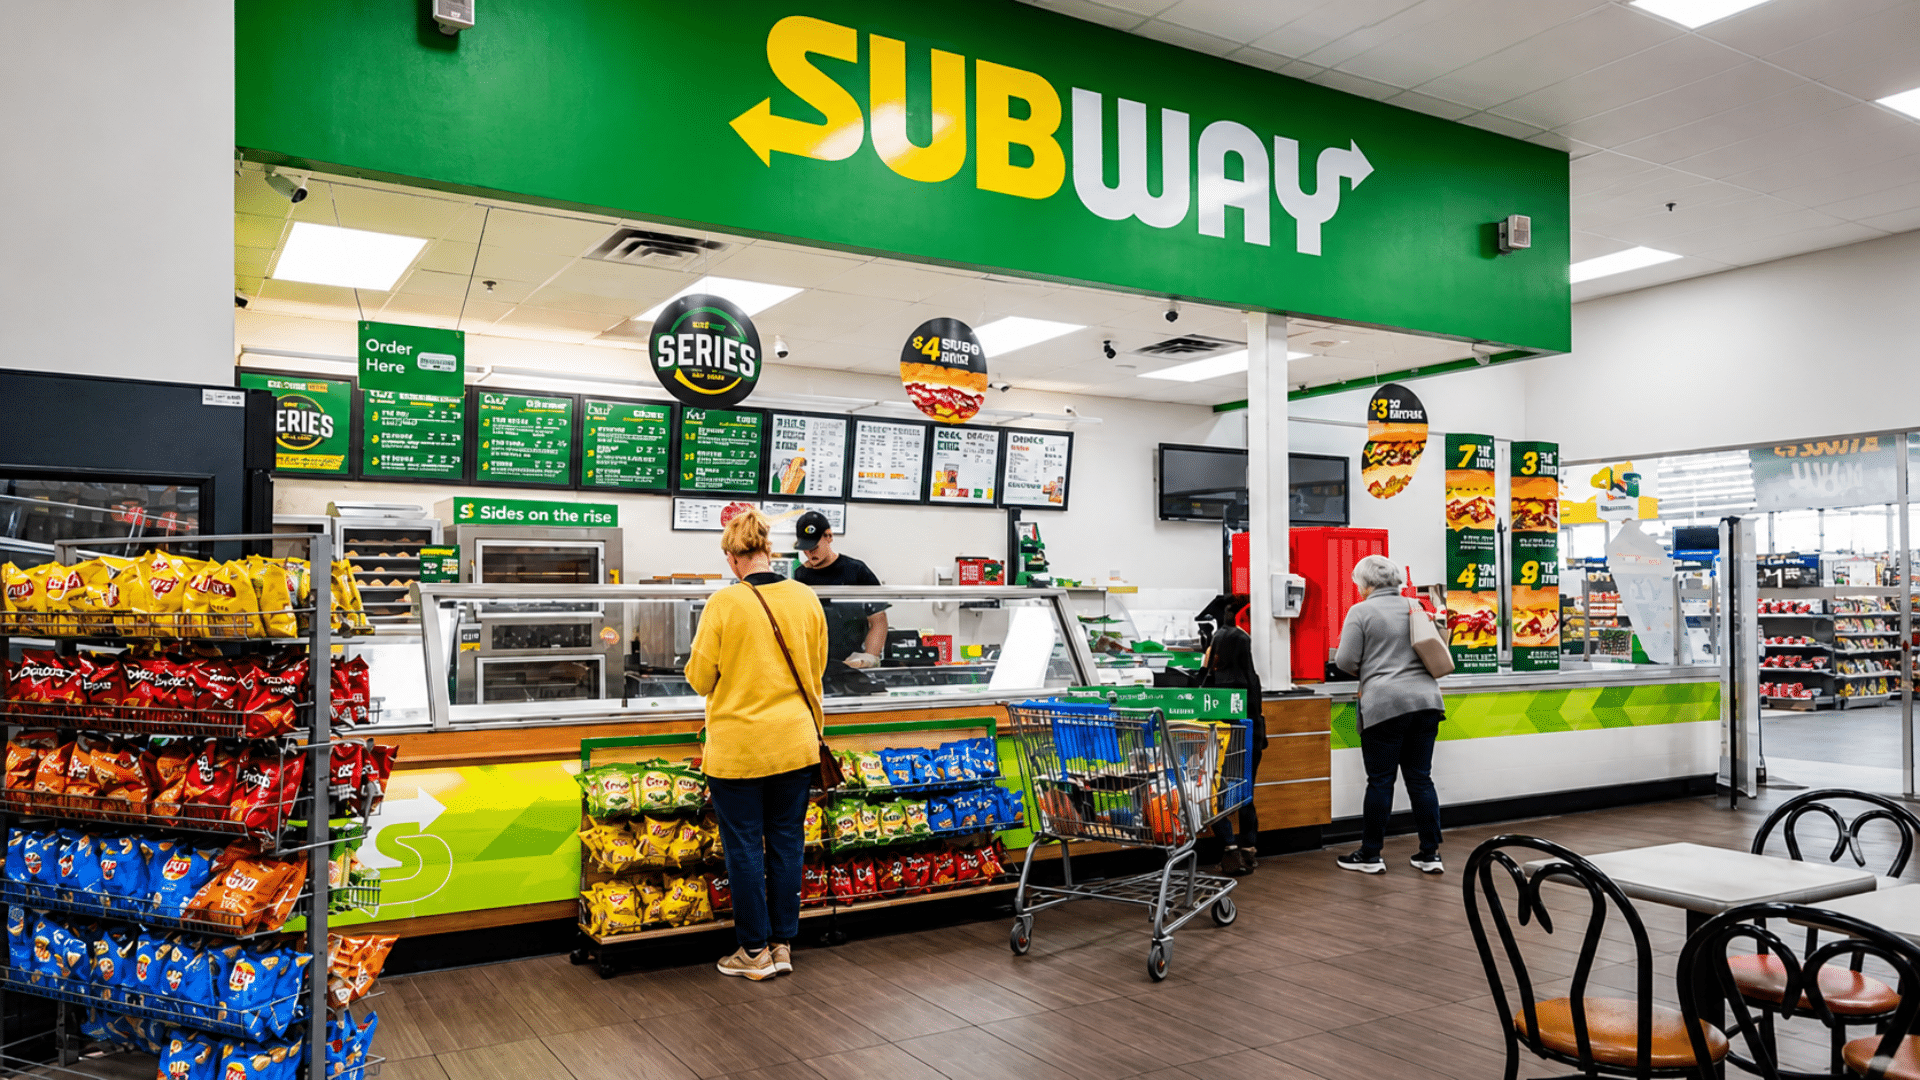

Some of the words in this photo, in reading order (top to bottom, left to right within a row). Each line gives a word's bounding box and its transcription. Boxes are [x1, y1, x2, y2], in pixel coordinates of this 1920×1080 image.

[729, 15, 1375, 256] SUBWAY
[365, 338, 413, 356] Order
[657, 333, 756, 378] SERIES
[365, 358, 406, 374] Here
[276, 409, 334, 438] ERIES
[480, 505, 525, 521] Sides
[528, 510, 549, 521] on
[553, 509, 579, 522] the
[583, 509, 612, 523] rise
